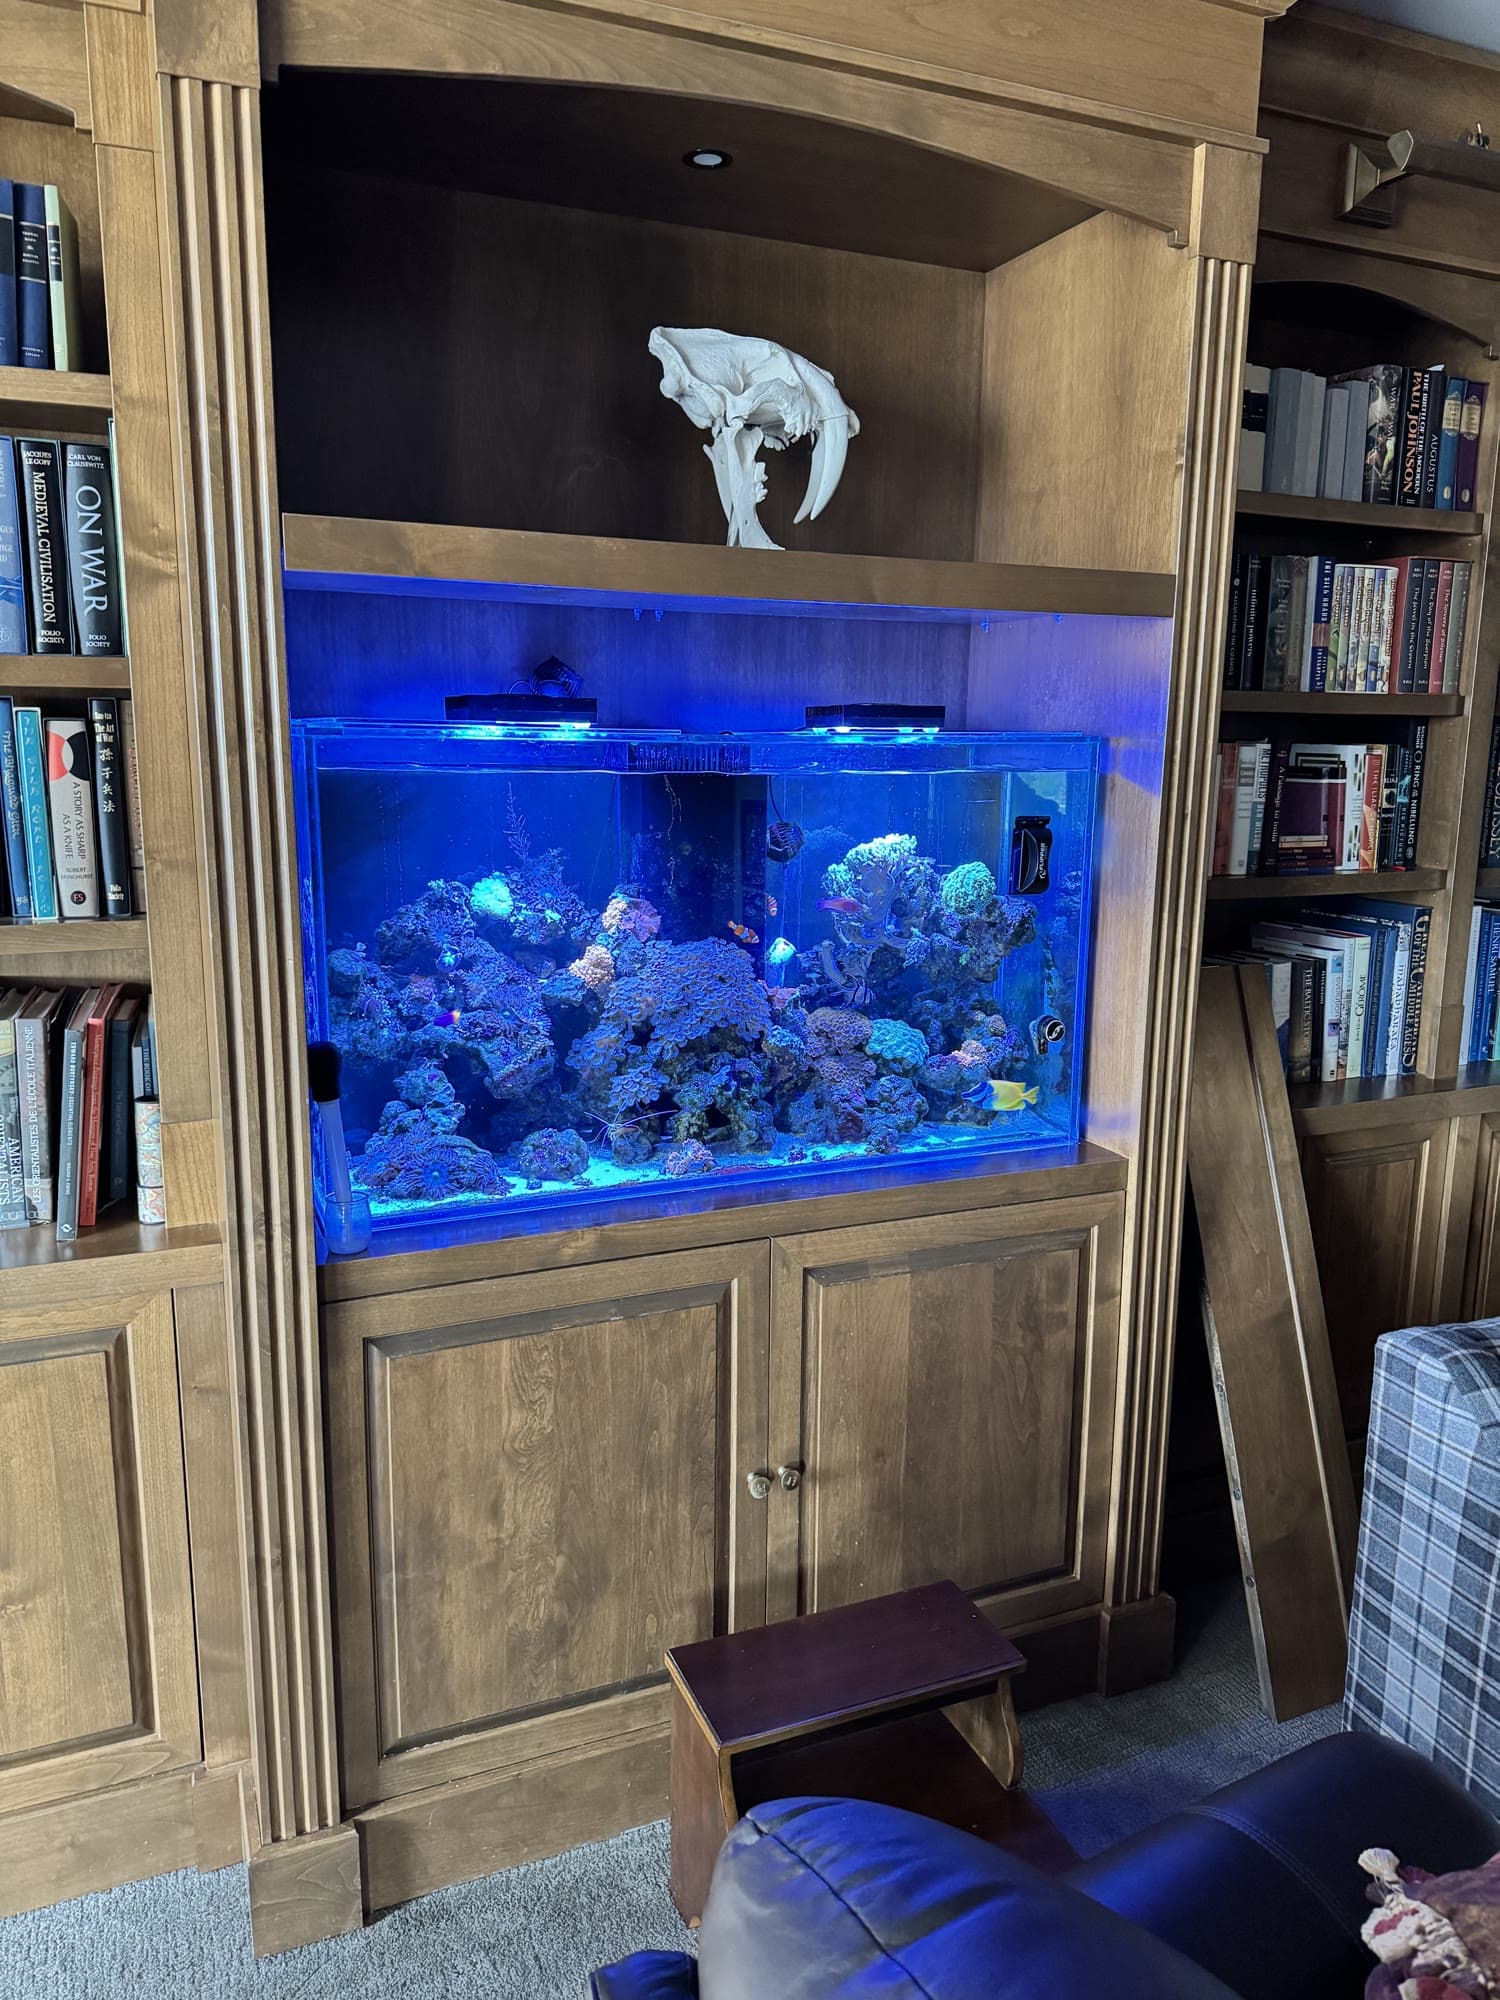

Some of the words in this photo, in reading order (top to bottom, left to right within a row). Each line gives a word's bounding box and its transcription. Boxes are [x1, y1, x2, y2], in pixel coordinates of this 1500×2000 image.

[1410, 371, 1422, 411] PAUL
[1419, 421, 1426, 433] OF
[23, 450, 52, 459] JACQUES
[25, 457, 33, 466] LE
[34, 458, 51, 467] GOFF
[67, 460, 104, 470] CLAUSEWITZ
[68, 453, 86, 461] CARL
[1403, 411, 1420, 493] JOHNSON
[1426, 434, 1438, 493] AUGUSTUS
[32, 471, 50, 537] MEDIEVAL
[75, 485, 103, 537] ON
[38, 538, 57, 624] CIVILISATION
[79, 546, 108, 617] WAR
[39, 636, 65, 645] SOCIETY
[40, 629, 61, 637] FOLIO
[1257, 748, 1271, 799] METROPOLIS
[1372, 770, 1380, 784] THE
[1412, 765, 1421, 788] RING
[73, 790, 84, 818] STORY
[1370, 787, 1379, 809] ILIAD
[62, 814, 71, 826] AS
[76, 819, 84, 832] AS
[1273, 810, 1280, 819] to
[1407, 800, 1417, 844] NIBELUNG
[1271, 821, 1280, 842] India
[64, 835, 74, 860] KNIFE
[76, 833, 87, 860] SHARP
[1413, 933, 1423, 948] OF
[1411, 949, 1421, 968] THE
[1304, 967, 1313, 987] THE
[1487, 954, 1497, 993] SAMUEL
[1303, 988, 1312, 1020] BALTIC
[1355, 976, 1367, 1017] GÉRÔME
[1406, 982, 1418, 1025] MIDDLE
[24, 1026, 35, 1071] ITALIENNE
[1302, 1021, 1311, 1051] STORY
[1403, 1026, 1413, 1055] AGES
[26, 1072, 37, 1109] L'ÉCOLE
[28, 1110, 38, 1123] DE
[29, 1125, 41, 1186] ORIENTALISTES
[8, 1137, 24, 1203] AMERICAN
[32, 1188, 41, 1203] LES
